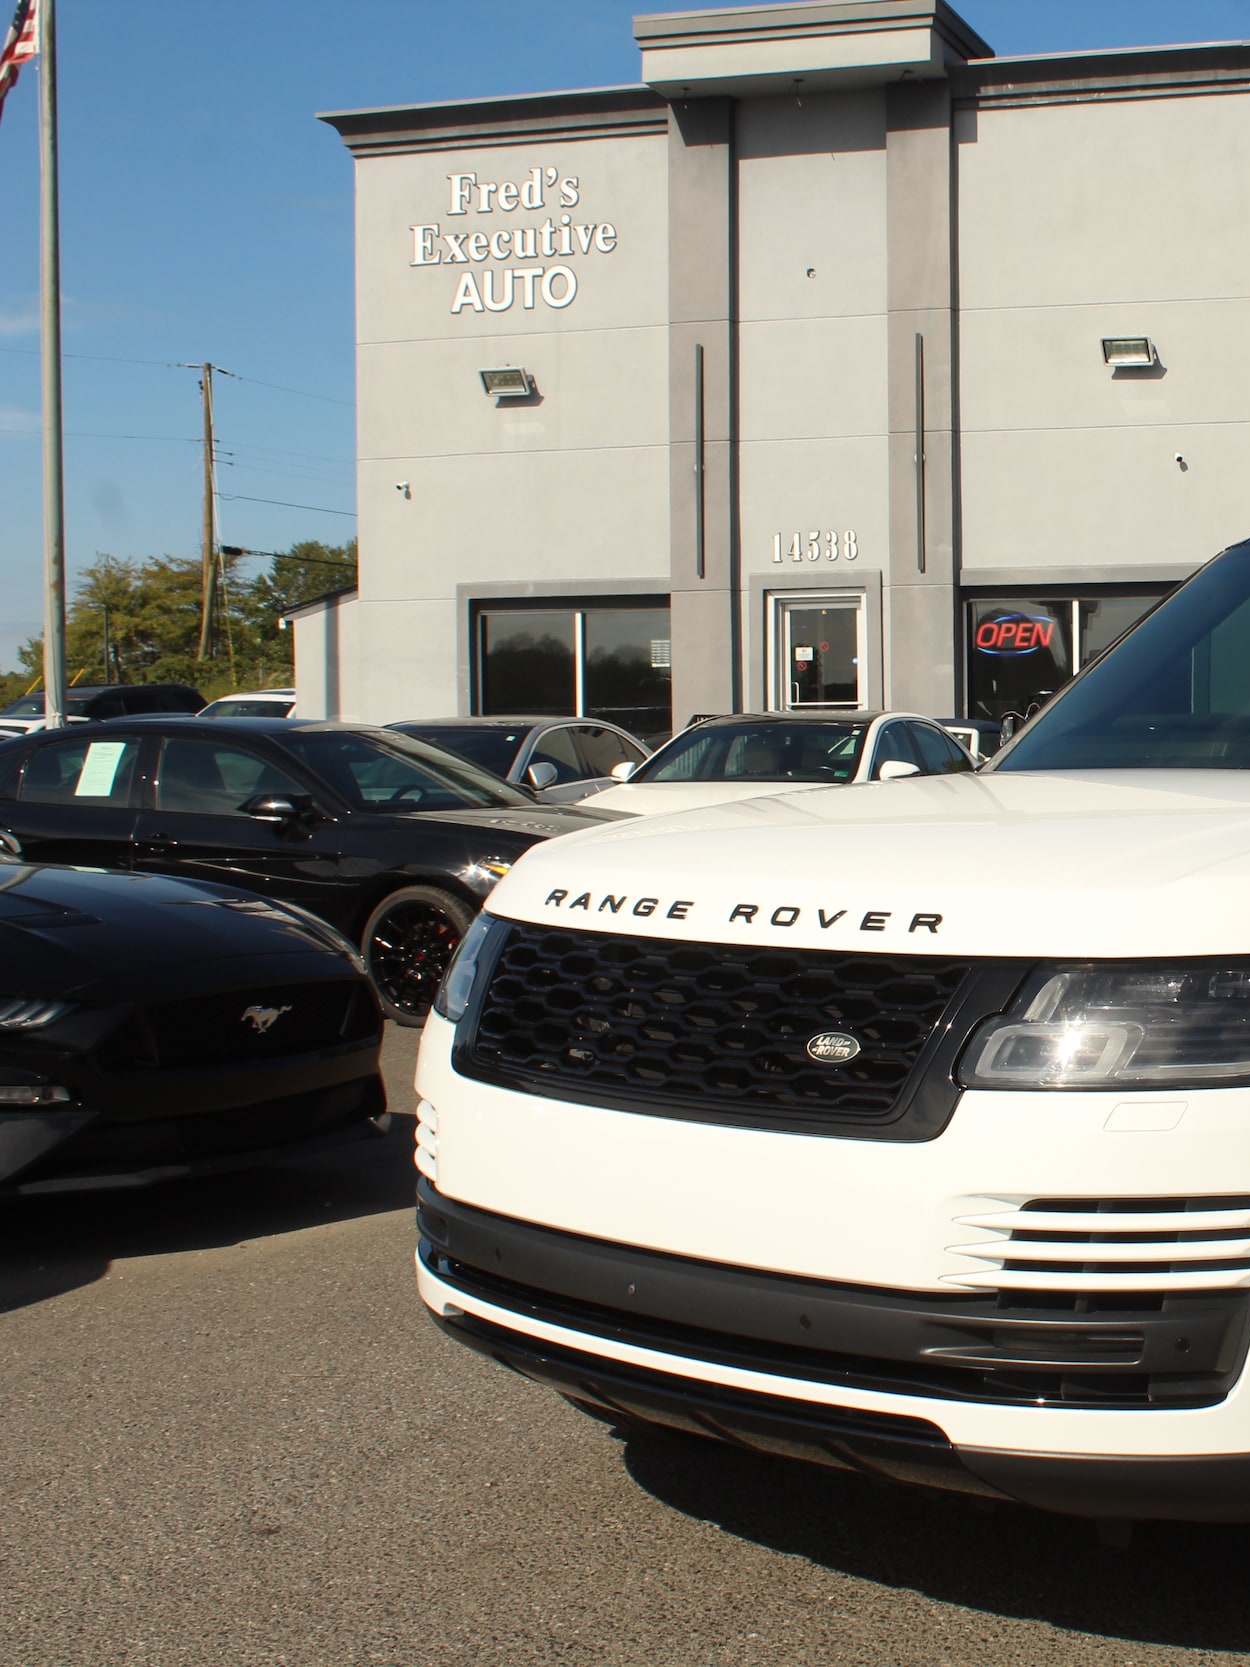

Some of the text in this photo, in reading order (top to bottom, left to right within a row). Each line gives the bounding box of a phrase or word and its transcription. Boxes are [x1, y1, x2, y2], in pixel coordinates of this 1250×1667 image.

[446, 166, 579, 215] Fred's
[409, 214, 617, 266] Executive
[450, 264, 578, 314] AUTO
[771, 528, 859, 563] 14538
[976, 622, 1055, 648] OPEN
[544, 888, 943, 934] RANGE ROVER
[816, 1036, 845, 1046] LAND
[816, 1046, 850, 1057] ROVER
